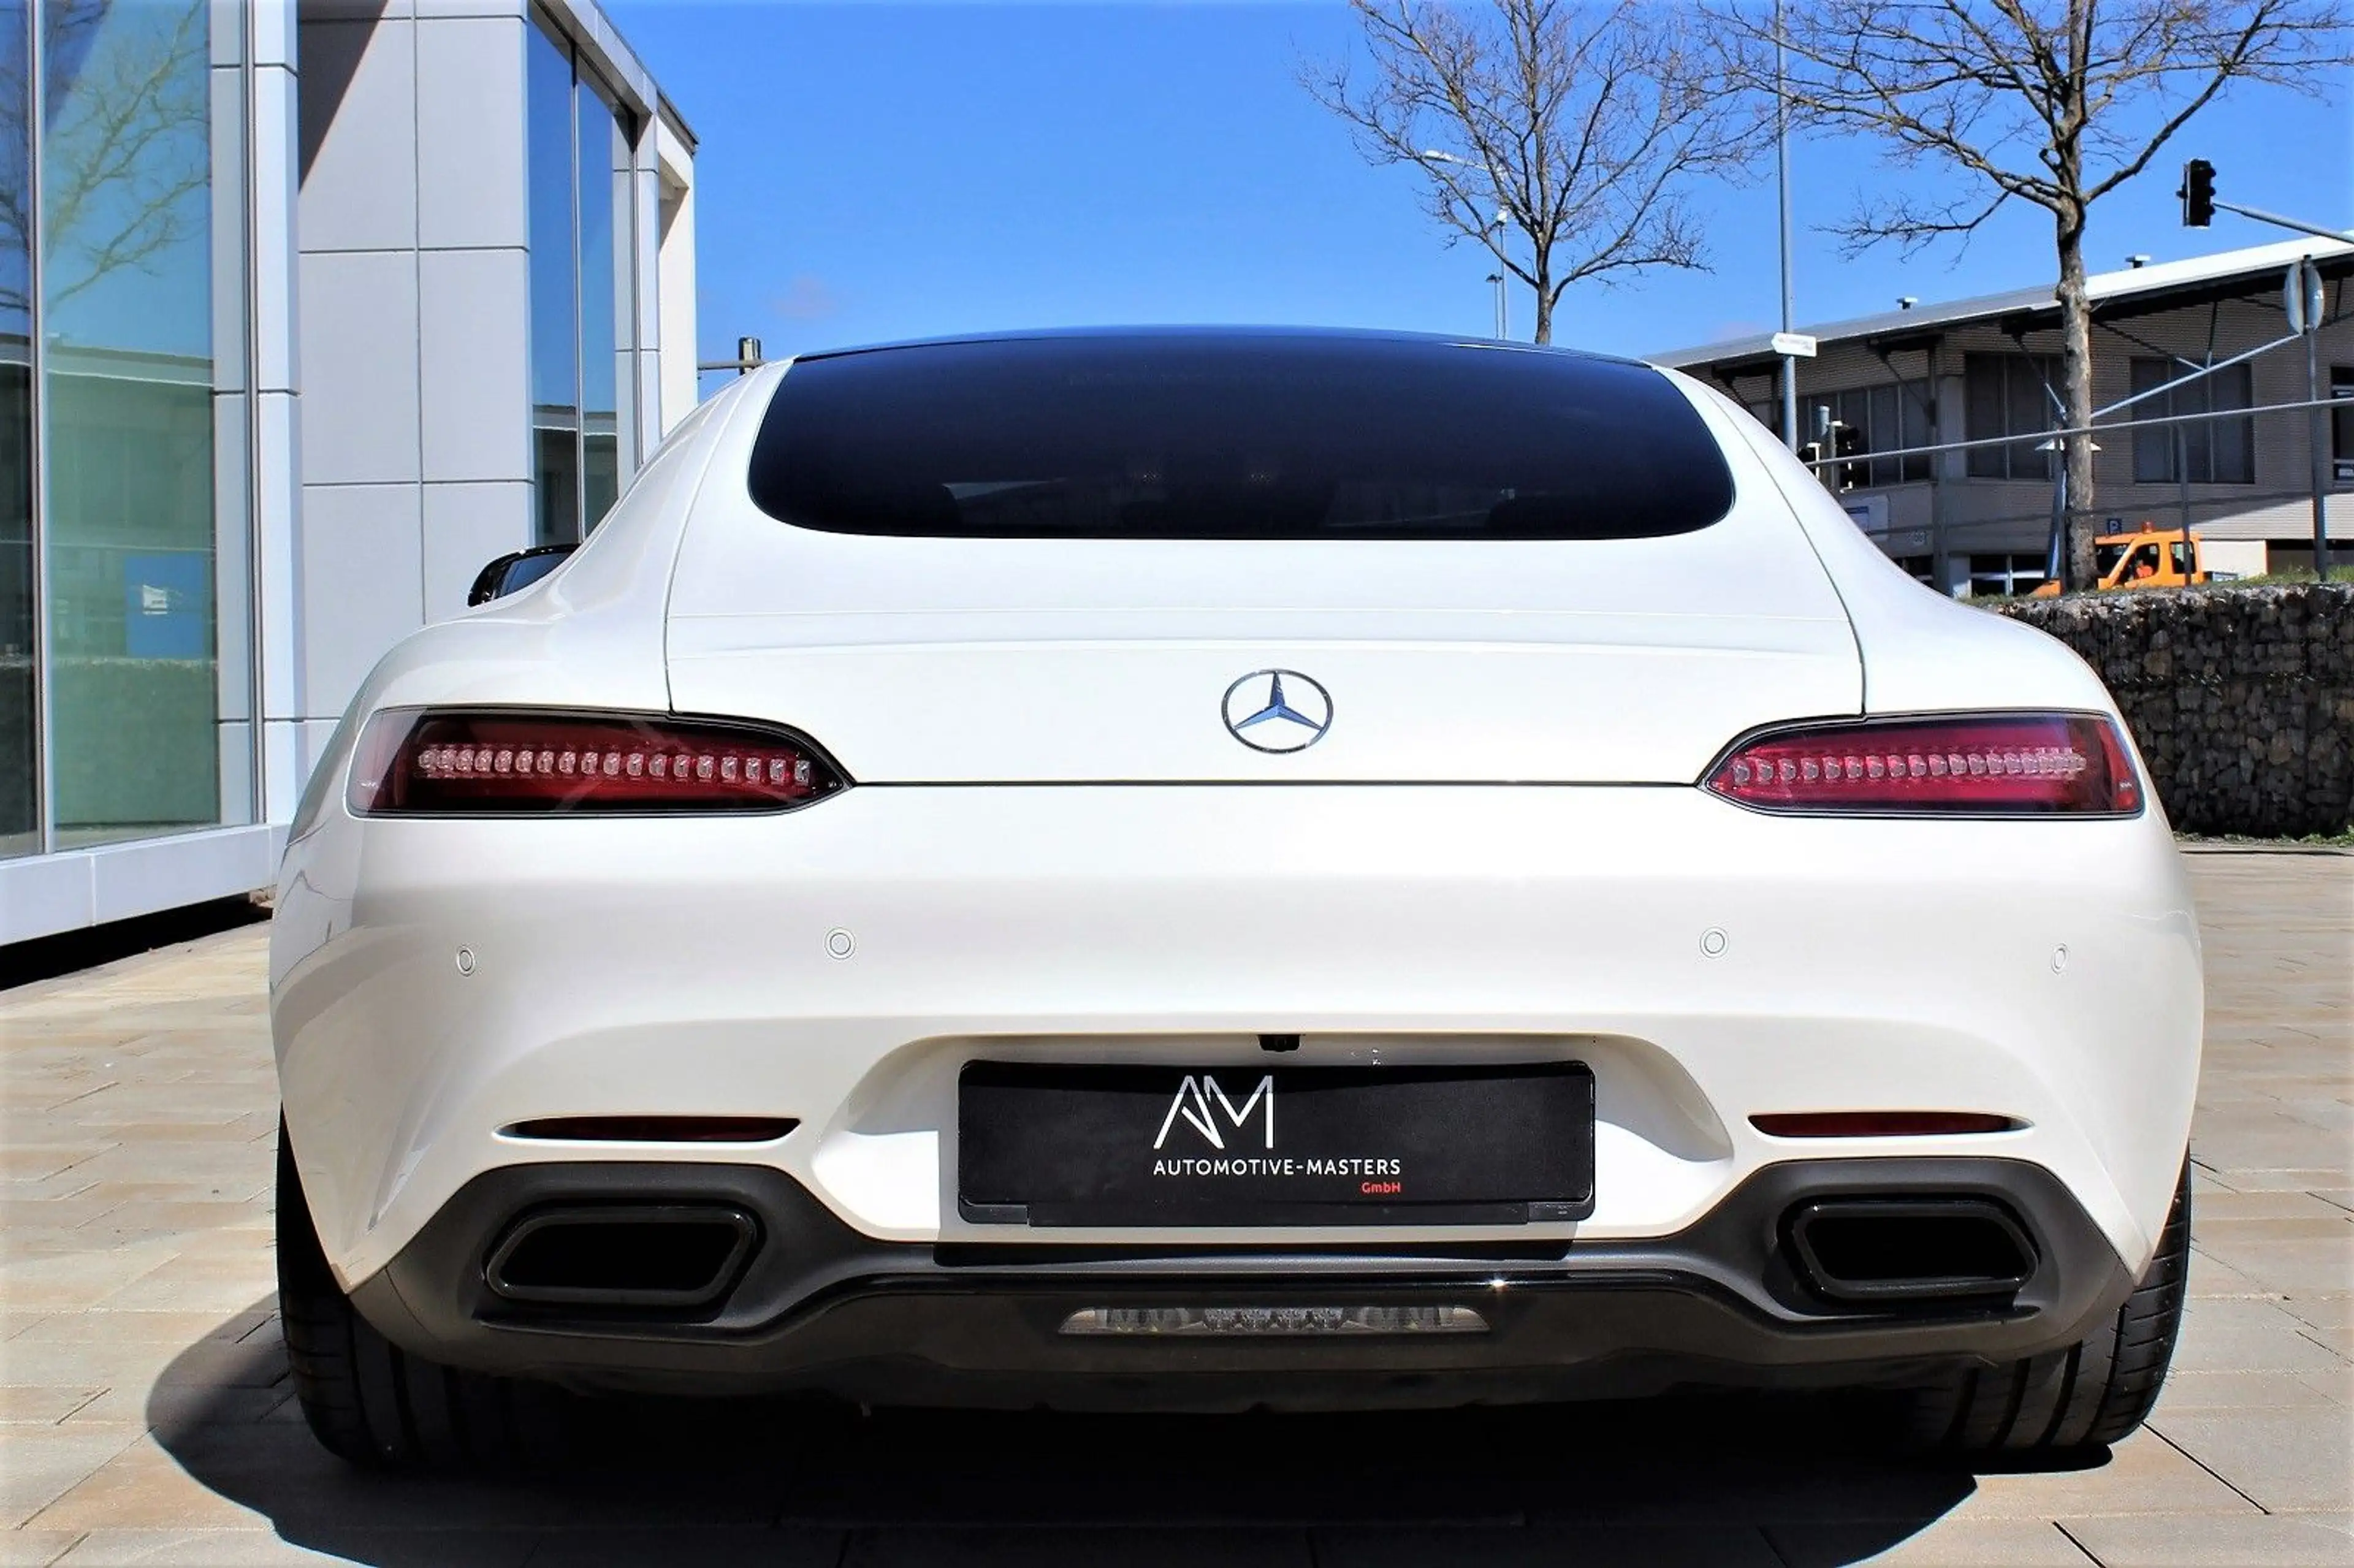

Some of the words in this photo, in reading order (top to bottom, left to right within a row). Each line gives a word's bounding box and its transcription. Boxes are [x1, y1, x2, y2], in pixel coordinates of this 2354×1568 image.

[2109, 520, 2119, 534] P
[1153, 1075, 1274, 1149] AM
[1153, 1159, 1400, 1176] AUTOMOTIVE-MASTERS
[1362, 1181, 1401, 1193] GmbH
